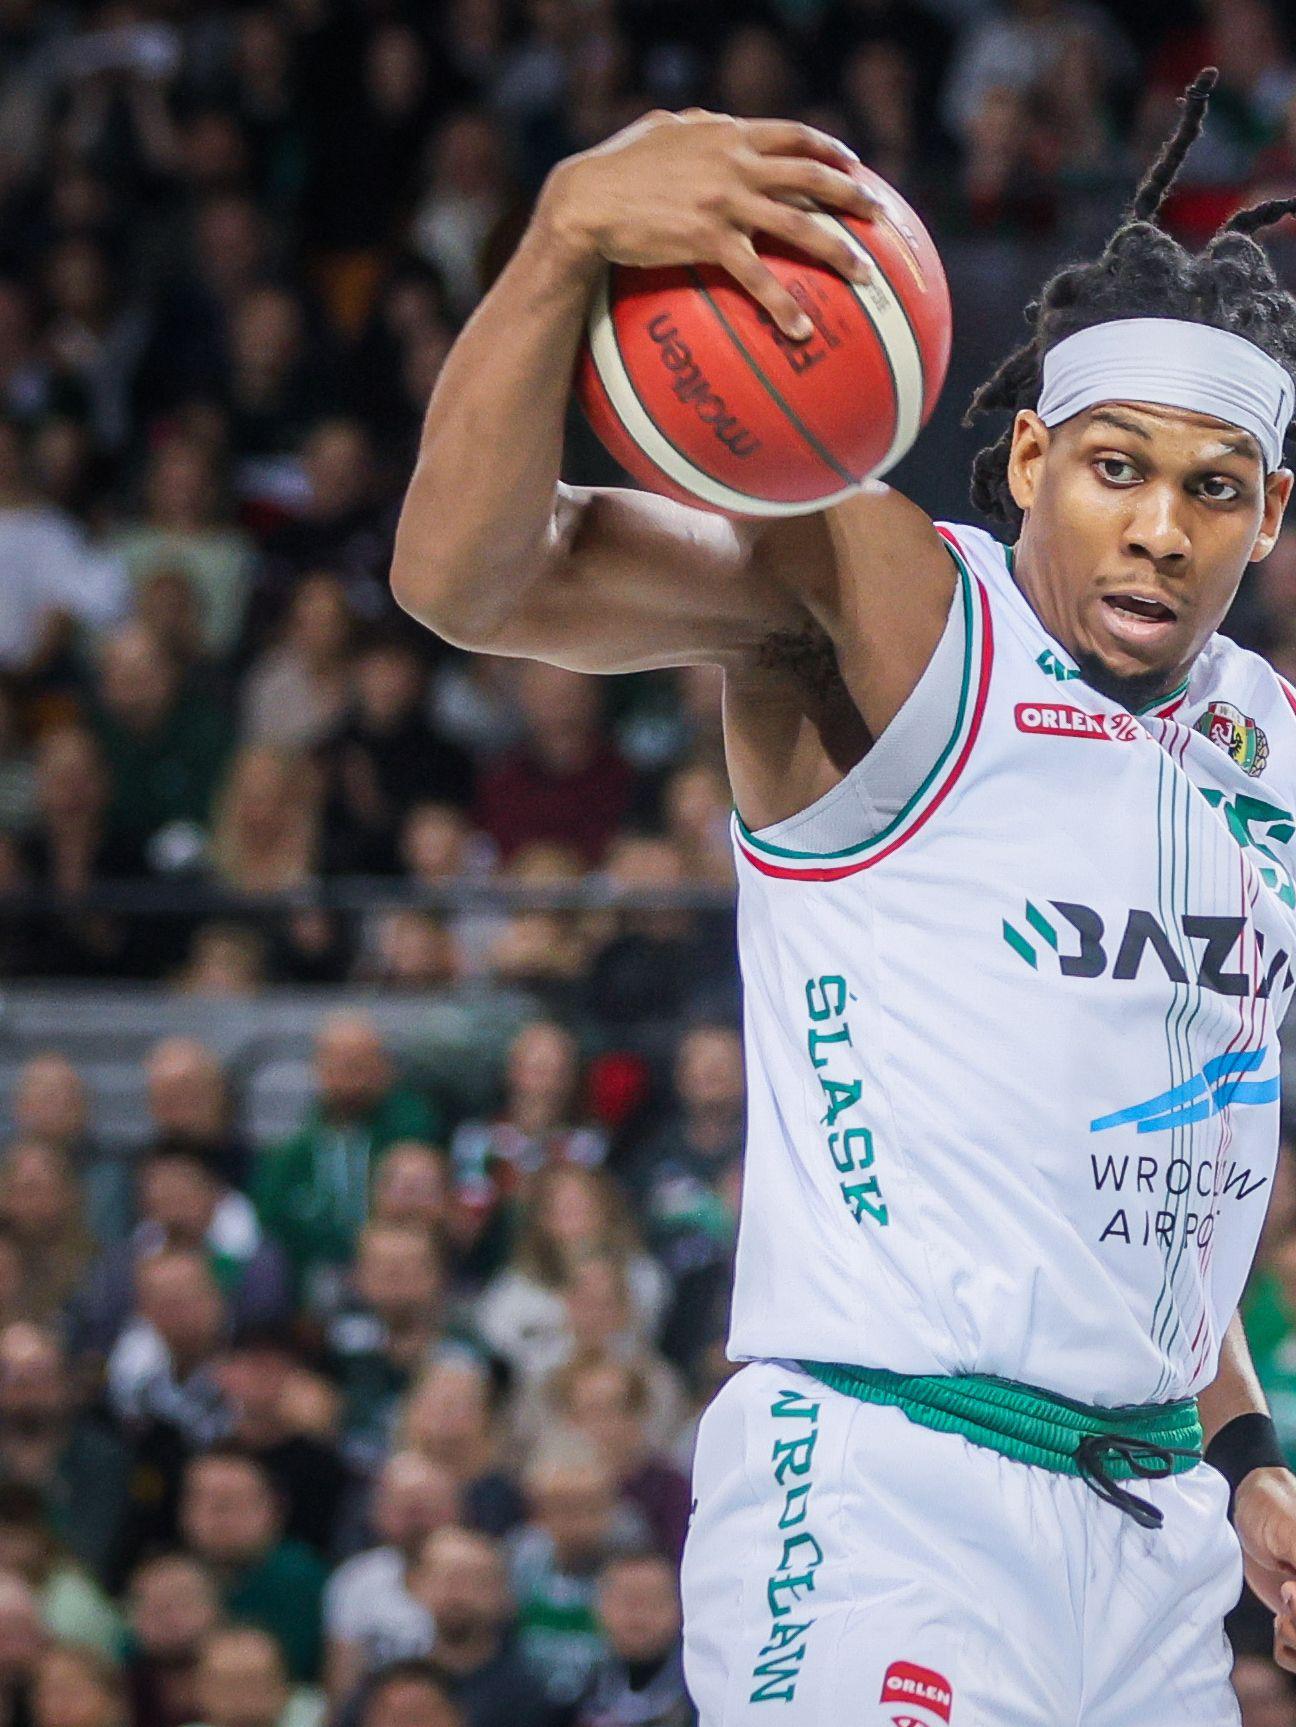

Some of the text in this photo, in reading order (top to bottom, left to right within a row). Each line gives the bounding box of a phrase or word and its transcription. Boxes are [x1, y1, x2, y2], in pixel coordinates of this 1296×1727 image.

[647, 312, 763, 459] molten
[1021, 707, 1104, 734] ORLEN
[886, 1675, 950, 1706] ORLEN
